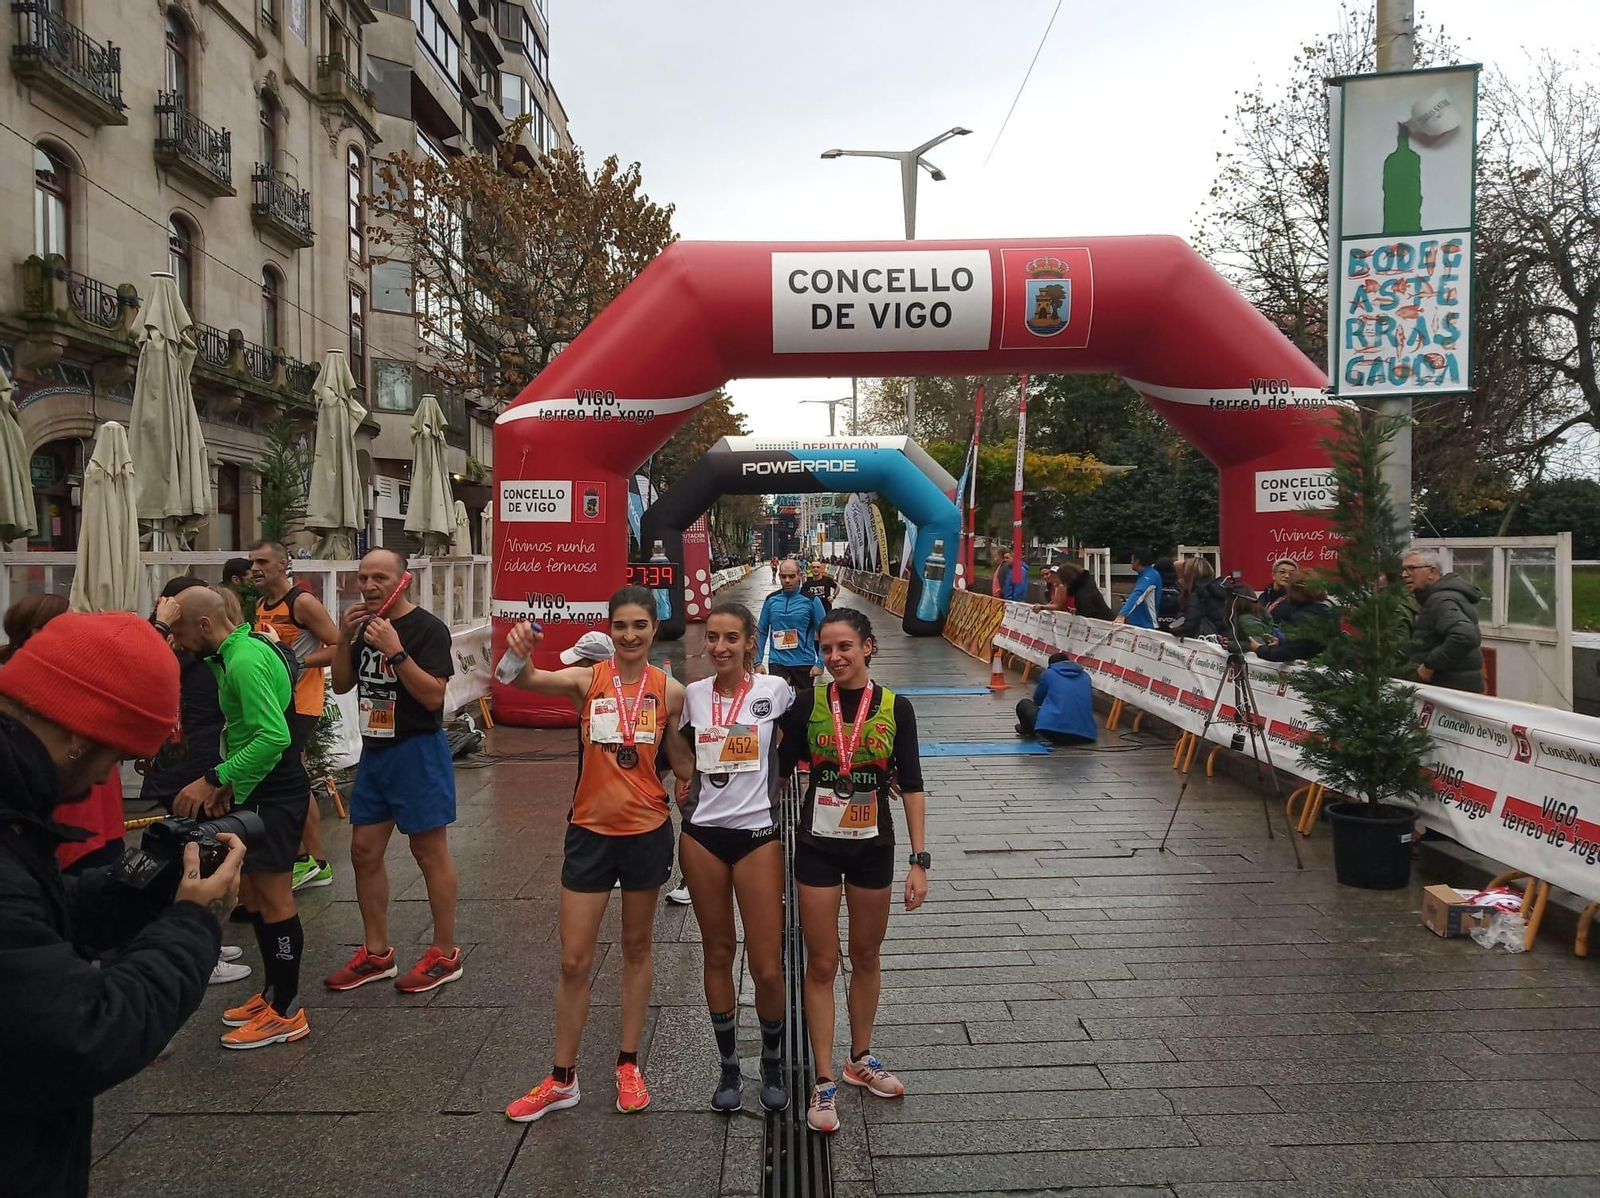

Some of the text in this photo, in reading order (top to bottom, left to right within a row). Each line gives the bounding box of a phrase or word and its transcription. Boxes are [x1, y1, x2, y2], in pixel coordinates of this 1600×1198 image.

[788, 267, 974, 294] CONCELLO
[812, 301, 952, 330] DE VIGO
[1249, 378, 1295, 397] VIGO,
[575, 389, 621, 408] VIGO,
[1209, 395, 1328, 412] terreo de xogo
[539, 407, 655, 424] terreo de xogo
[742, 459, 856, 475] POWERADE
[1261, 477, 1334, 490] CONCELLO
[503, 489, 565, 500] CONCELLO
[1269, 490, 1326, 503] DE VIGO
[508, 502, 557, 513] DE VIGO
[1269, 528, 1325, 543] Vivimos
[507, 538, 596, 553] Vivimos nunha
[1267, 547, 1314, 562] cidade
[504, 559, 597, 573] cidade fermosa
[525, 591, 570, 611] VIGO,
[500, 608, 603, 627] terreo de xogo
[372, 710, 387, 724] 178
[1438, 714, 1508, 747] Concello de Vigo
[728, 736, 752, 755] 452
[1539, 741, 1587, 764] Concello
[821, 769, 878, 785] 3NRTH
[1438, 787, 1488, 820] de xogo
[850, 804, 870, 822] 516
[1542, 796, 1580, 833] VIGO,
[751, 828, 774, 838] NIKE
[1502, 809, 1600, 865] terreo de xog
